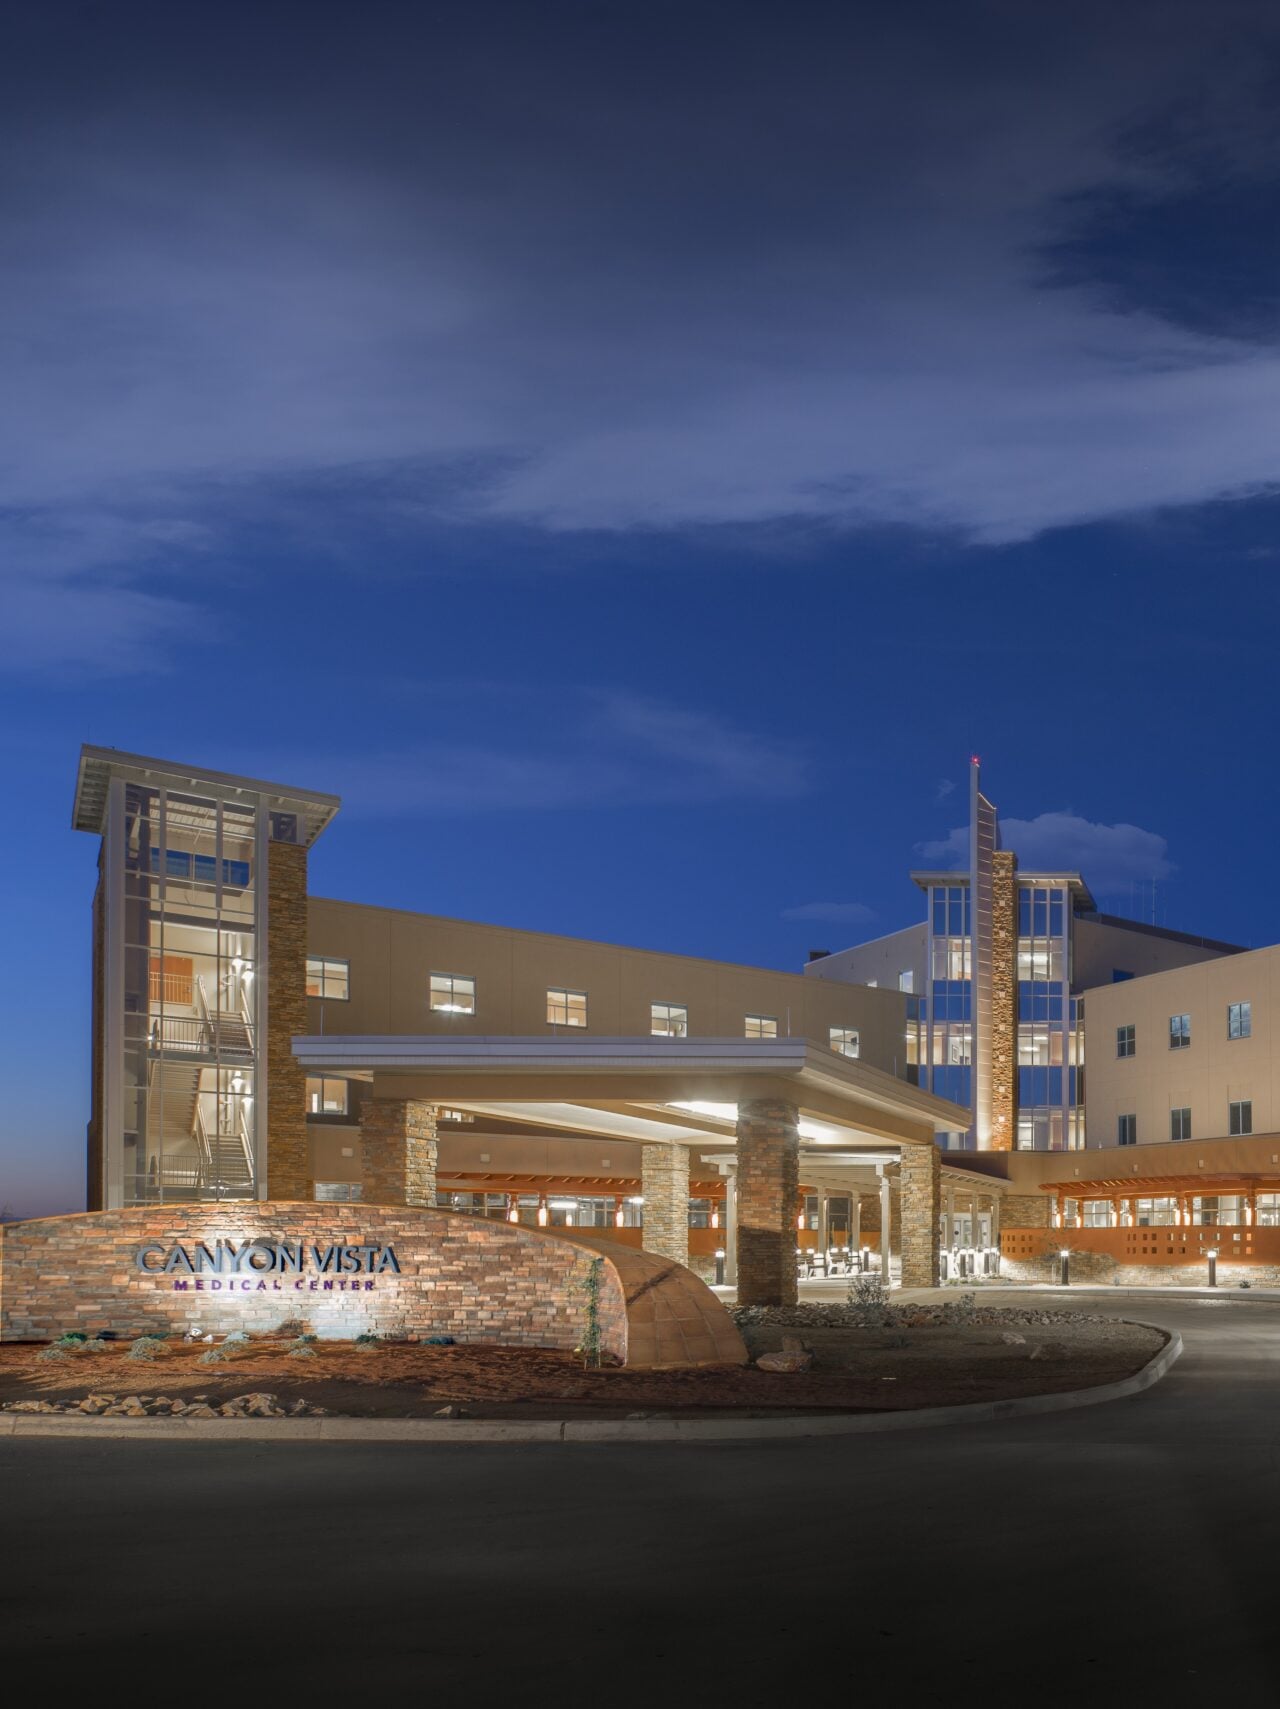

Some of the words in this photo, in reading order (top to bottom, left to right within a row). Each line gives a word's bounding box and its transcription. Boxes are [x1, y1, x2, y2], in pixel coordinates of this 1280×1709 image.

[136, 1246, 304, 1273] CANYON
[312, 1246, 401, 1273] VISTA
[174, 1280, 282, 1291] MEDICAL
[295, 1280, 375, 1291] CENTER
